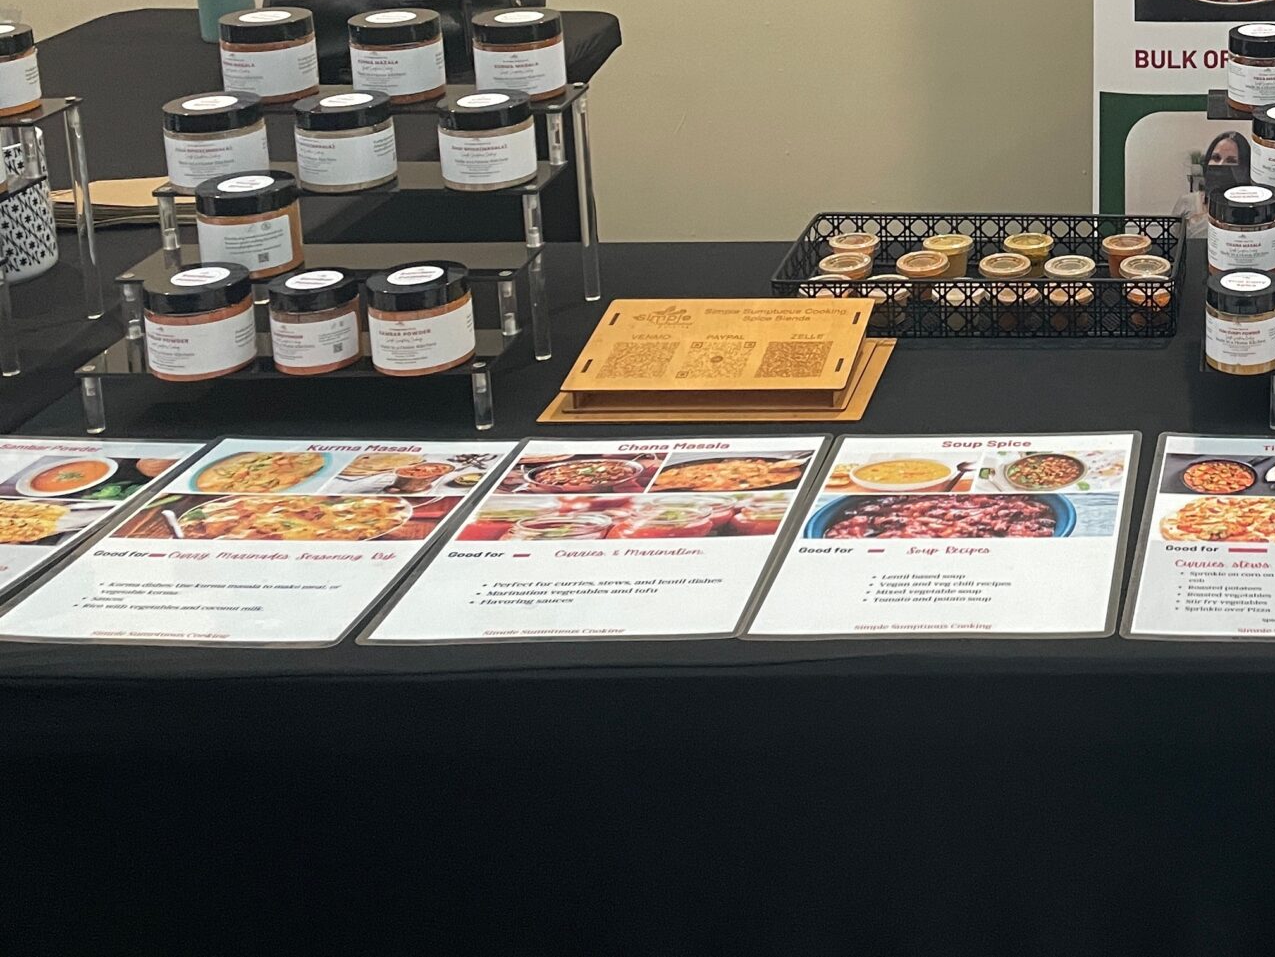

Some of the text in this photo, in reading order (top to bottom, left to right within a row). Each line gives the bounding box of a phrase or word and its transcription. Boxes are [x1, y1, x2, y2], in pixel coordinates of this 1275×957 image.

[1136, 50, 1197, 68] BULK
[987, 440, 1031, 448] Spice
[907, 547, 939, 555] Soup
